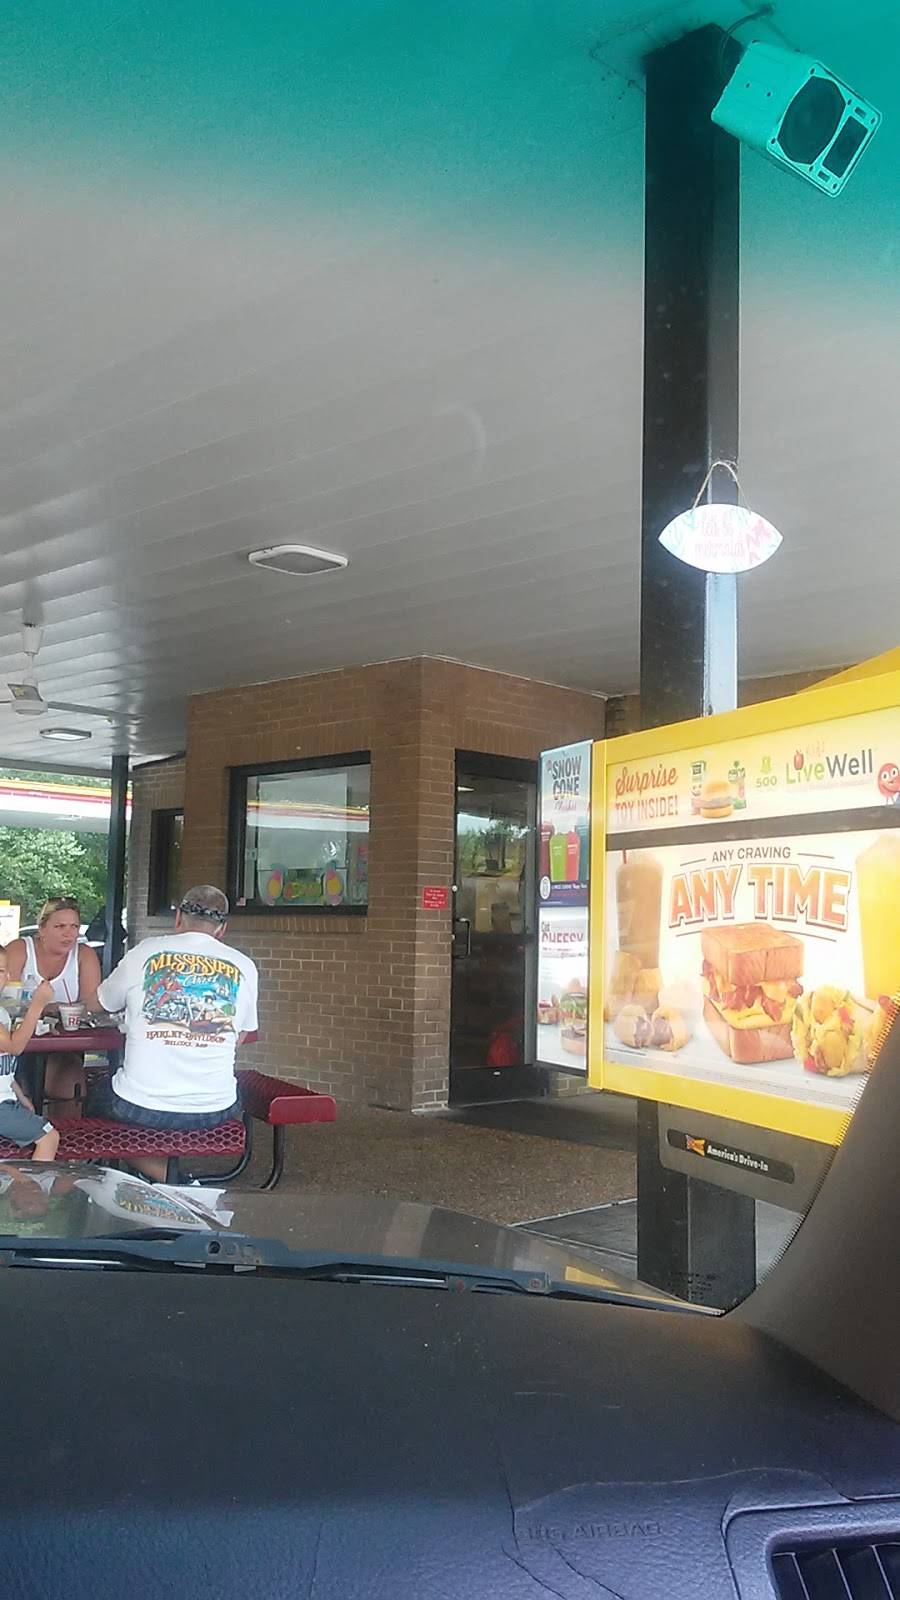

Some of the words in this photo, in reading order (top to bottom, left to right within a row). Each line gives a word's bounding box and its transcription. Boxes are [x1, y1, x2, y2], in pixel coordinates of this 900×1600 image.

[552, 756, 582, 780] SNOW
[785, 748, 874, 784] LiveWell
[553, 776, 580, 797] CONE
[615, 763, 678, 798] Surprise
[755, 775, 778, 788] 500
[615, 801, 635, 820] TOY
[637, 794, 679, 819] INSIDE!
[711, 849, 734, 863] ANY
[737, 846, 791, 860] CRAVING
[669, 864, 743, 928] ANY
[748, 863, 852, 932] TIME
[149, 953, 239, 983] MISSISSIPPI
[706, 1144, 738, 1163] America's
[739, 1153, 769, 1172] Drive-In
